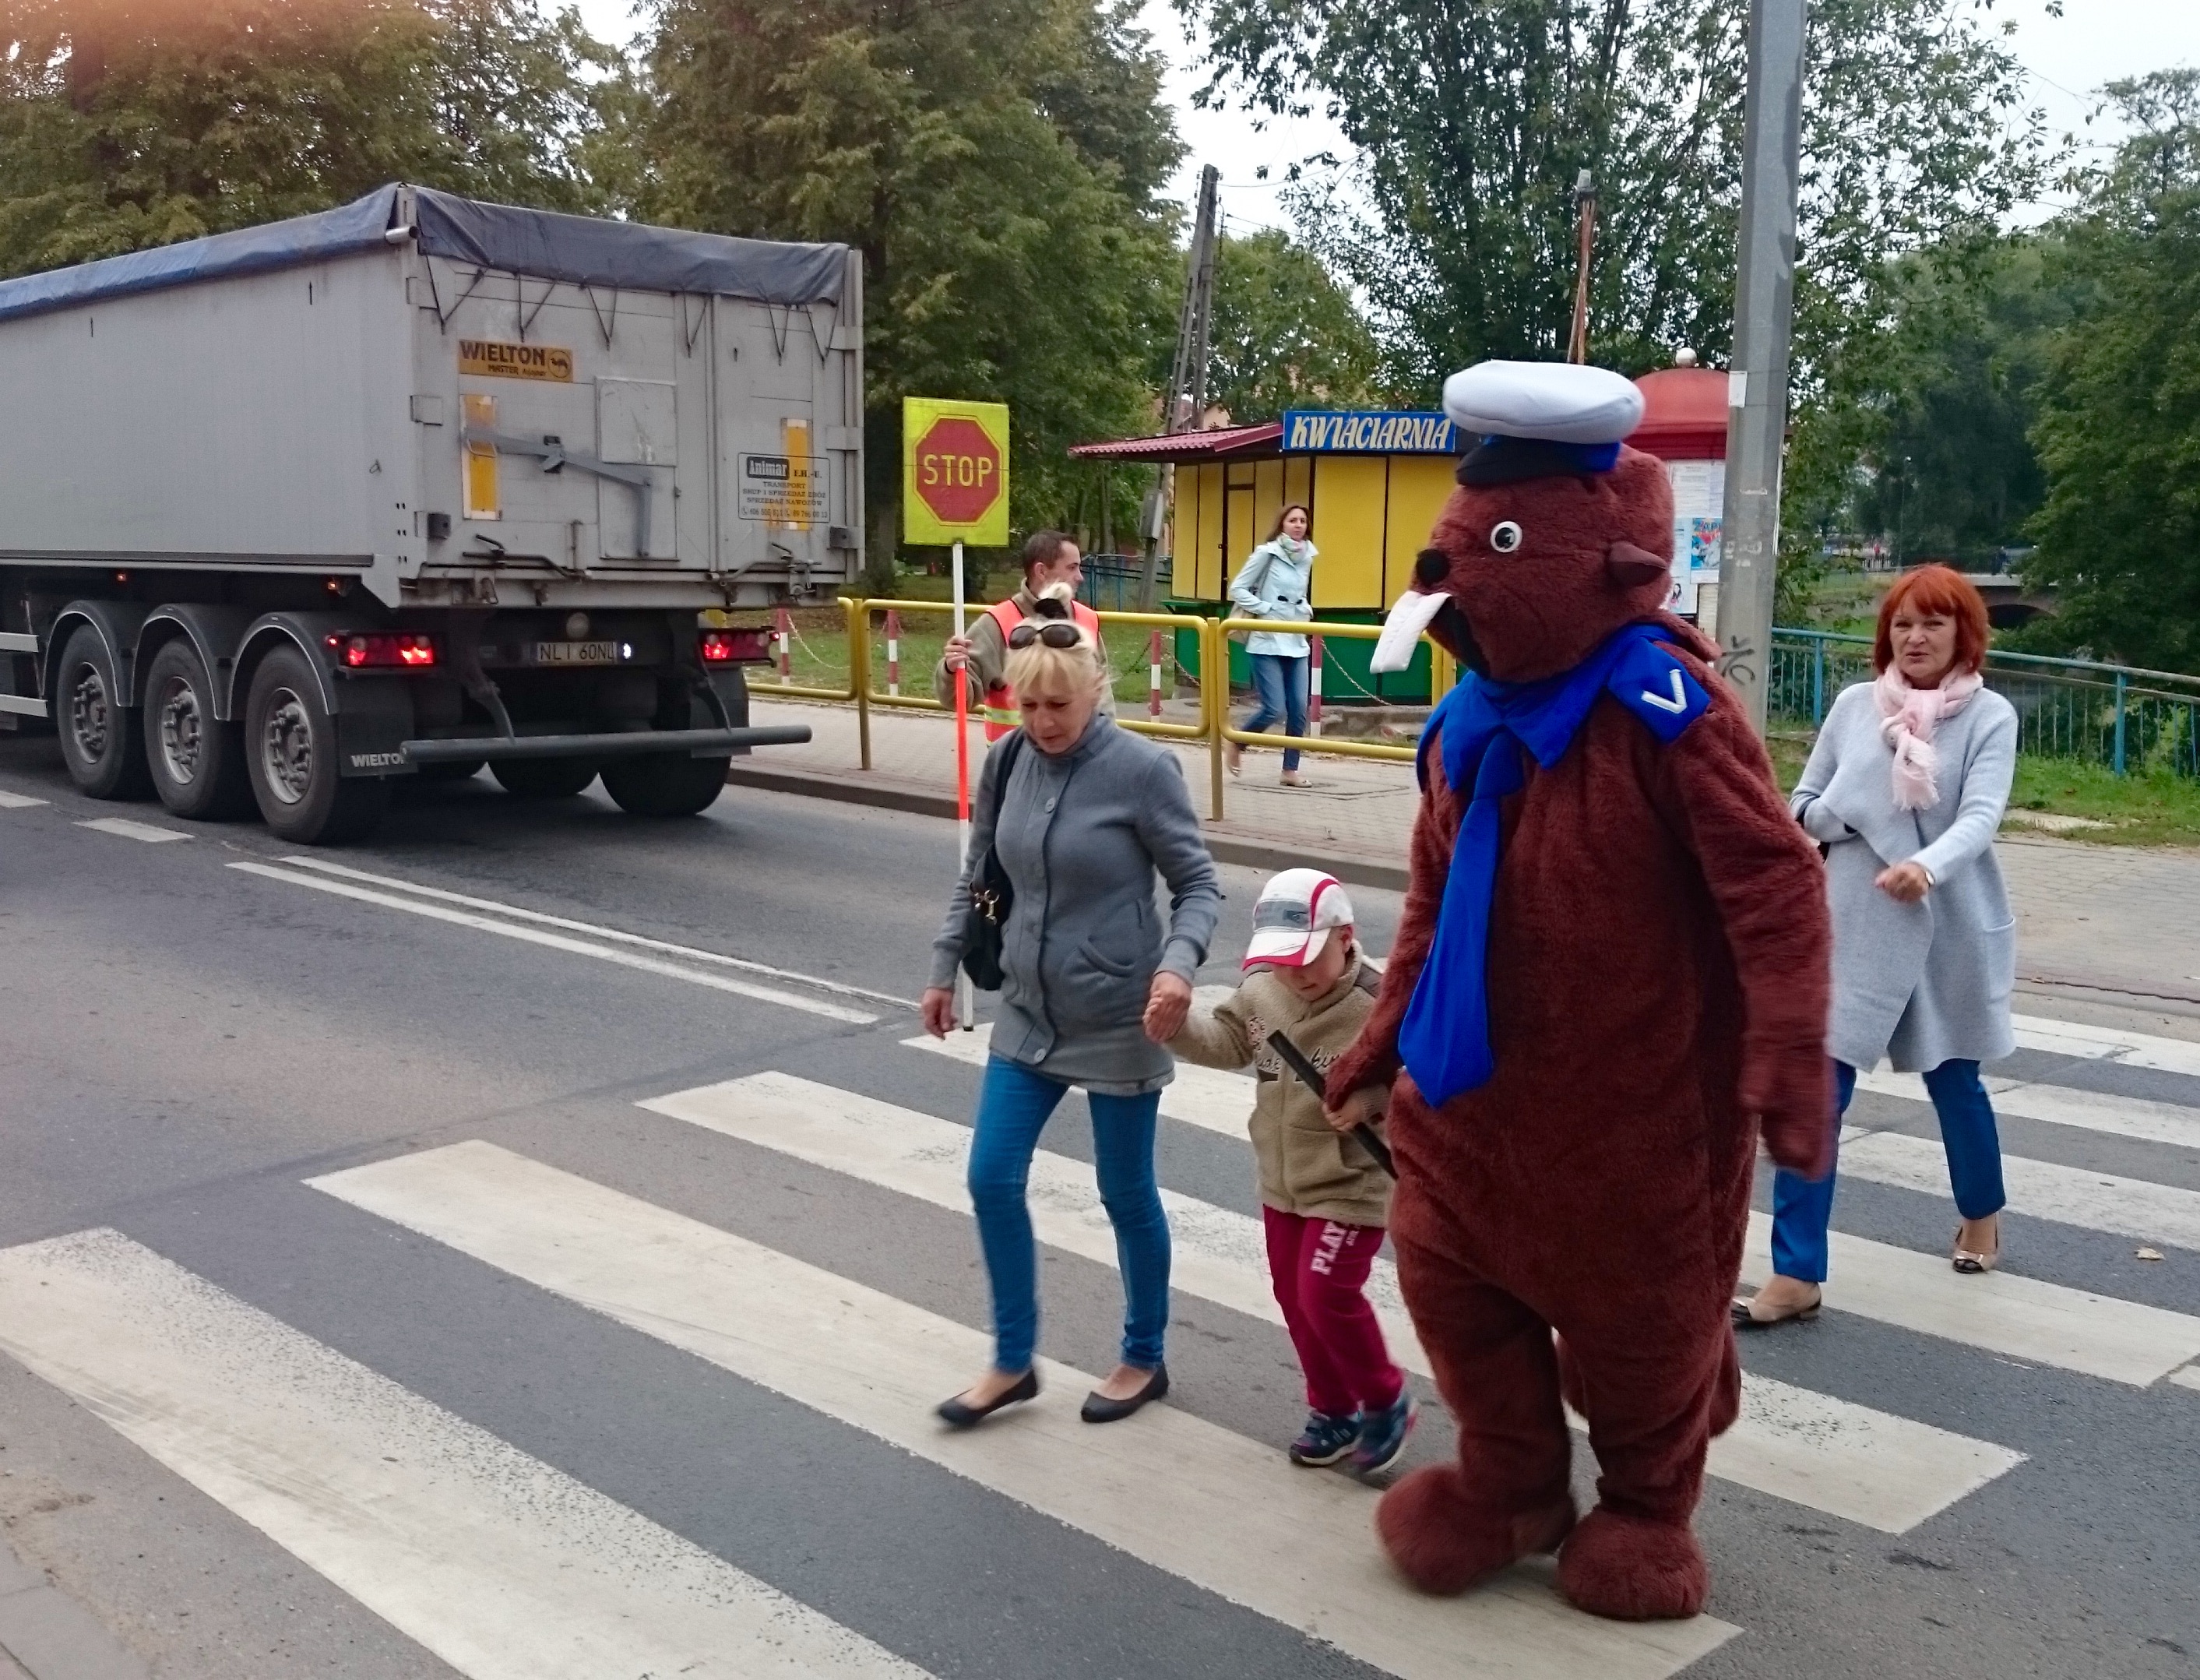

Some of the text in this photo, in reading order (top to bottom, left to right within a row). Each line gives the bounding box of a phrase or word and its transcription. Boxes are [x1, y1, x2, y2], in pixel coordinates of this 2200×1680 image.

[459, 340, 545, 366] WIELTON
[1290, 416, 1452, 449] KWIACIARNIA
[749, 460, 788, 477] Animar
[923, 453, 994, 488] STOP
[579, 643, 614, 660] 60NL
[350, 752, 404, 768] WIELTO
